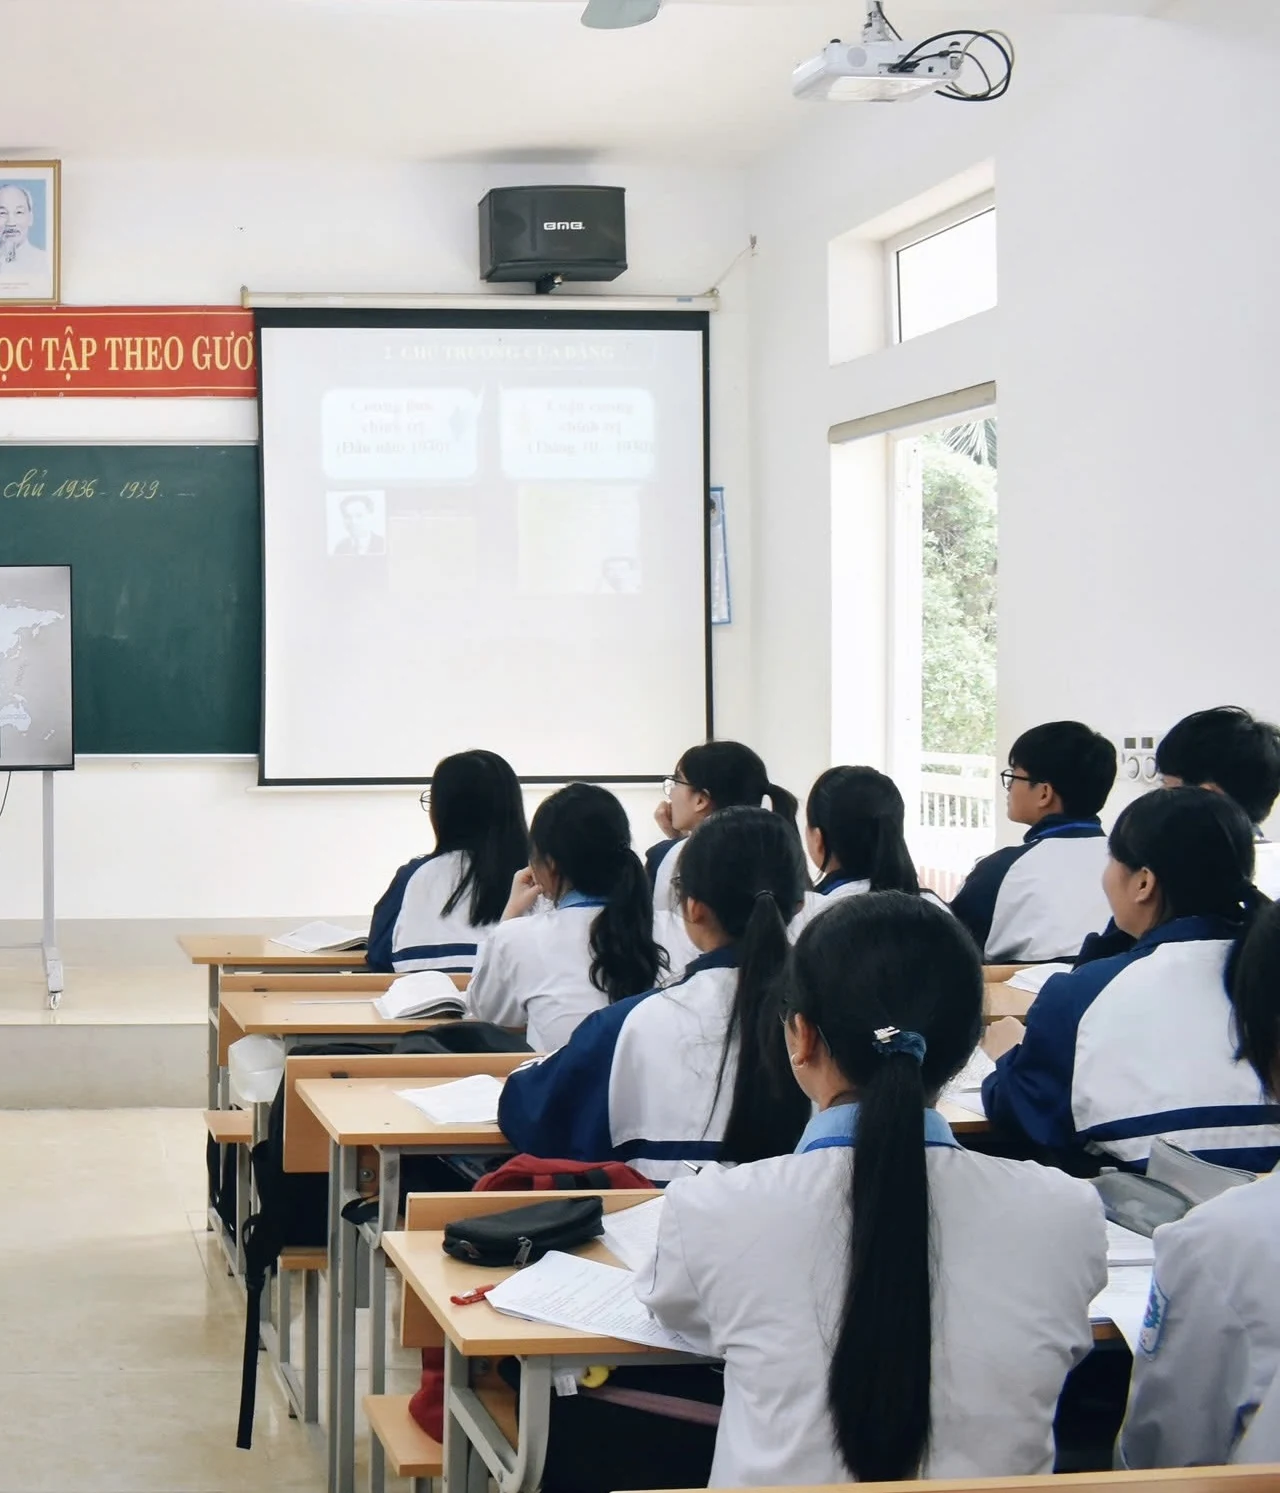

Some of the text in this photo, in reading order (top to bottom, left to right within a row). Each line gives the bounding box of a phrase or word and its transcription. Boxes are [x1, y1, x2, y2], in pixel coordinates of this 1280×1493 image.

[41, 326, 97, 382] TẬP
[105, 337, 184, 371] THEO
[192, 331, 255, 371] GƯƠ
[3, 468, 48, 498] chủ
[51, 478, 100, 499] 1936
